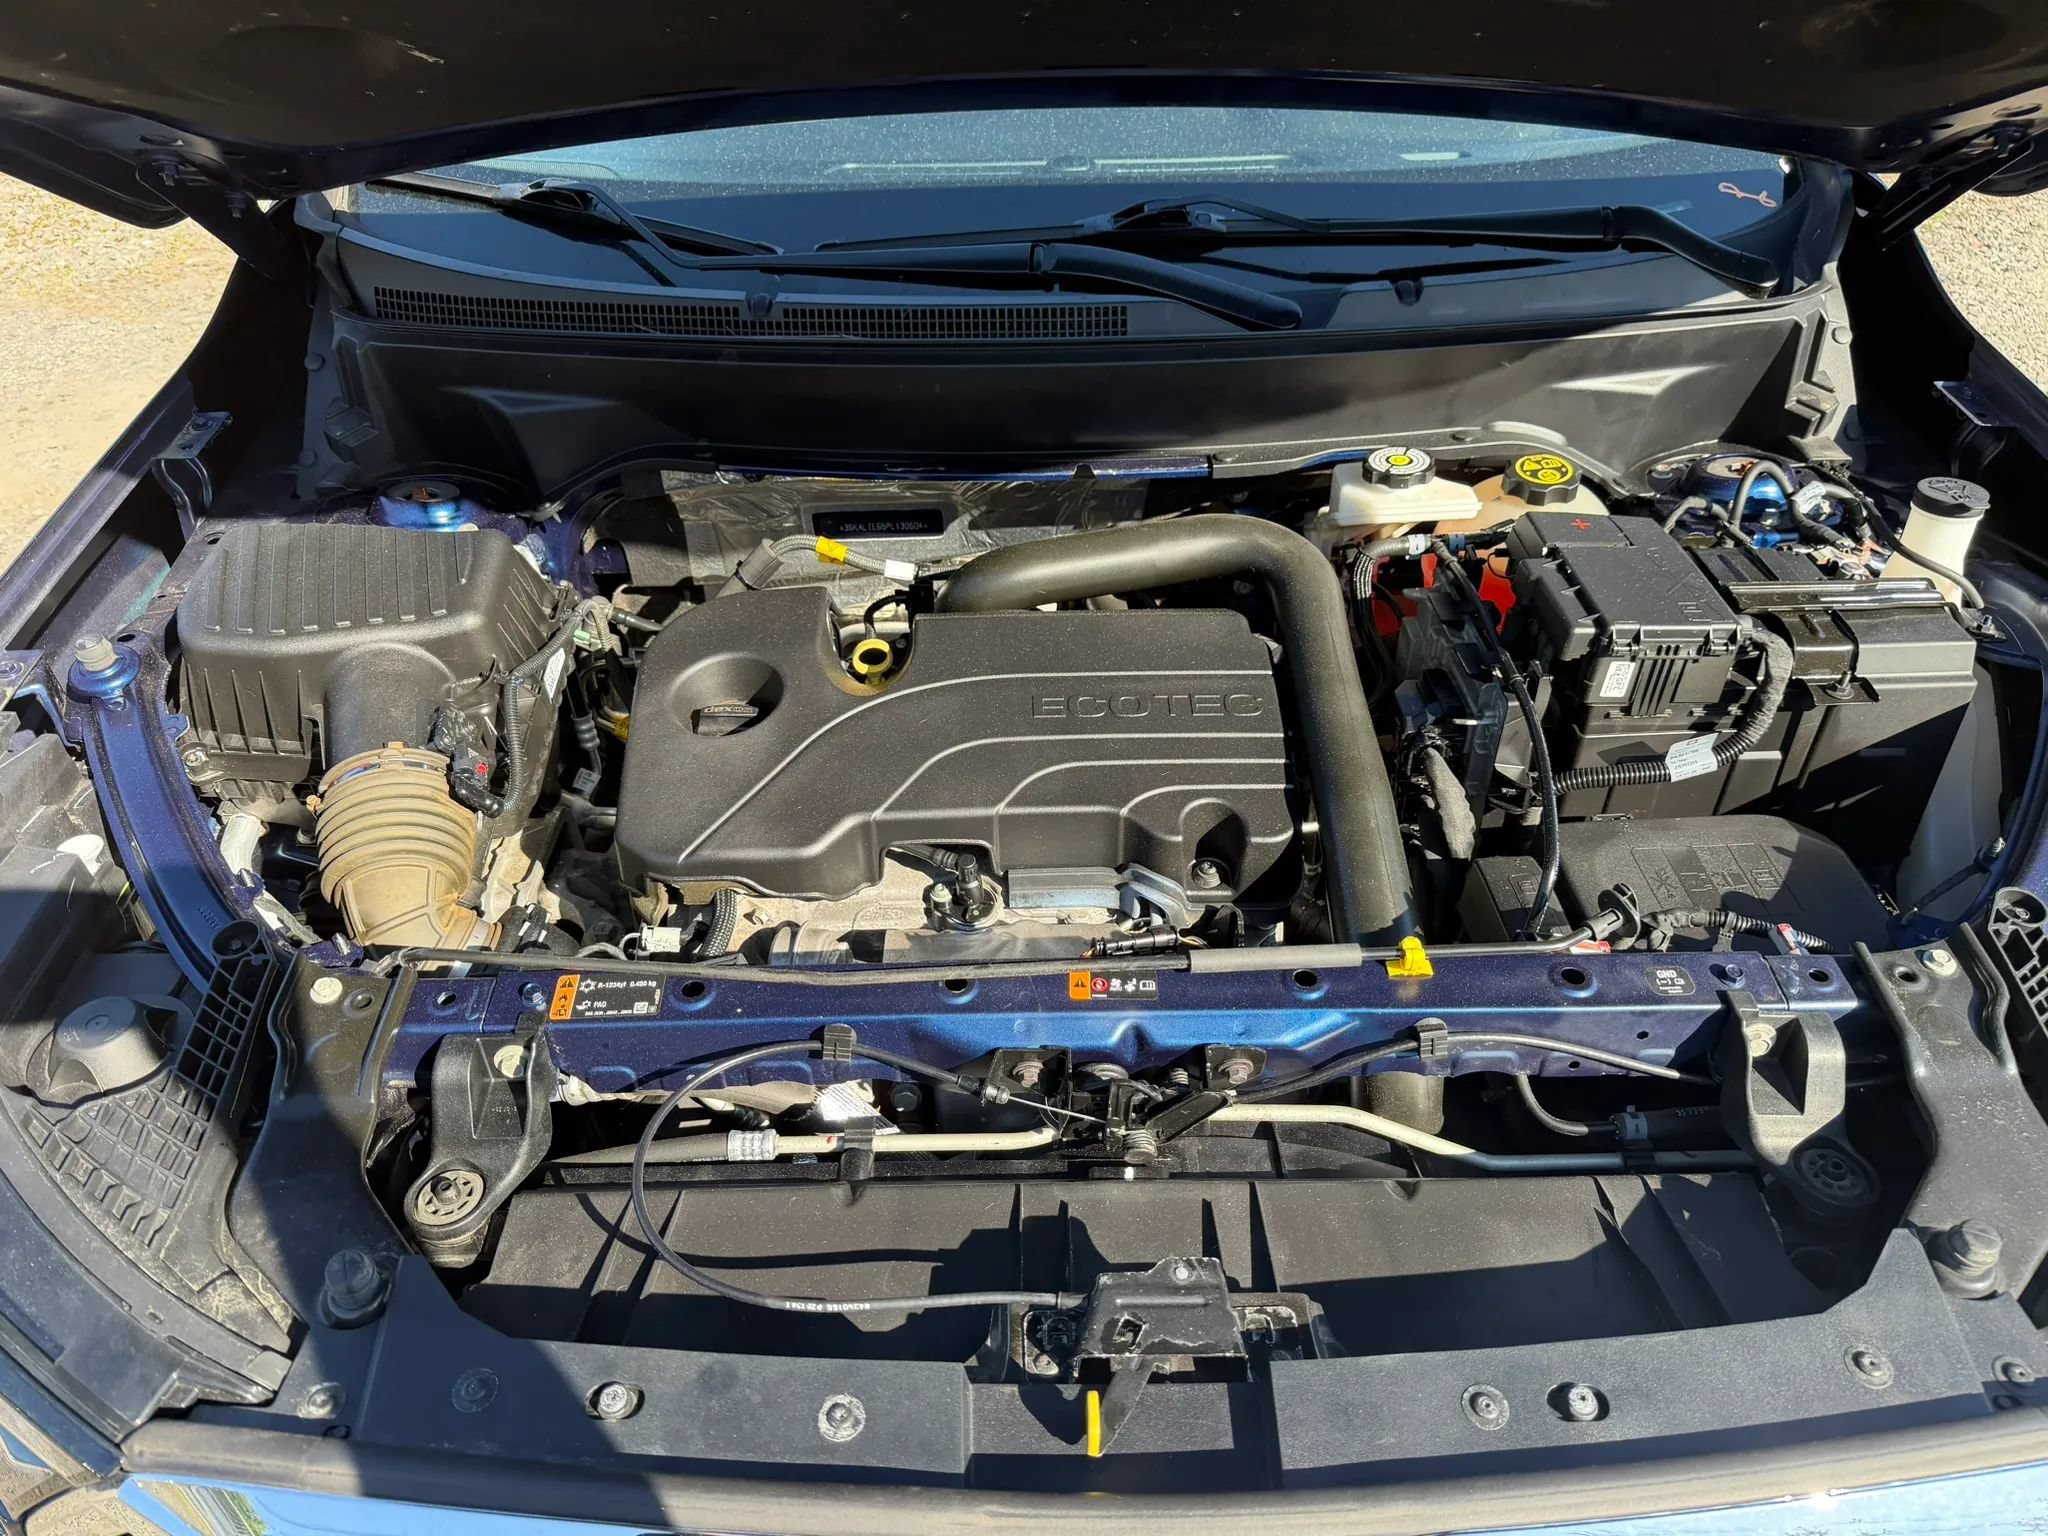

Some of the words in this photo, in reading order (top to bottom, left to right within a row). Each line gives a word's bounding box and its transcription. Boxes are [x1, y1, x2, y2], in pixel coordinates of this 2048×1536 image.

[704, 705, 753, 713] dexos
[1031, 694, 1264, 718] ECOTEC
[1656, 969, 1677, 978] GND
